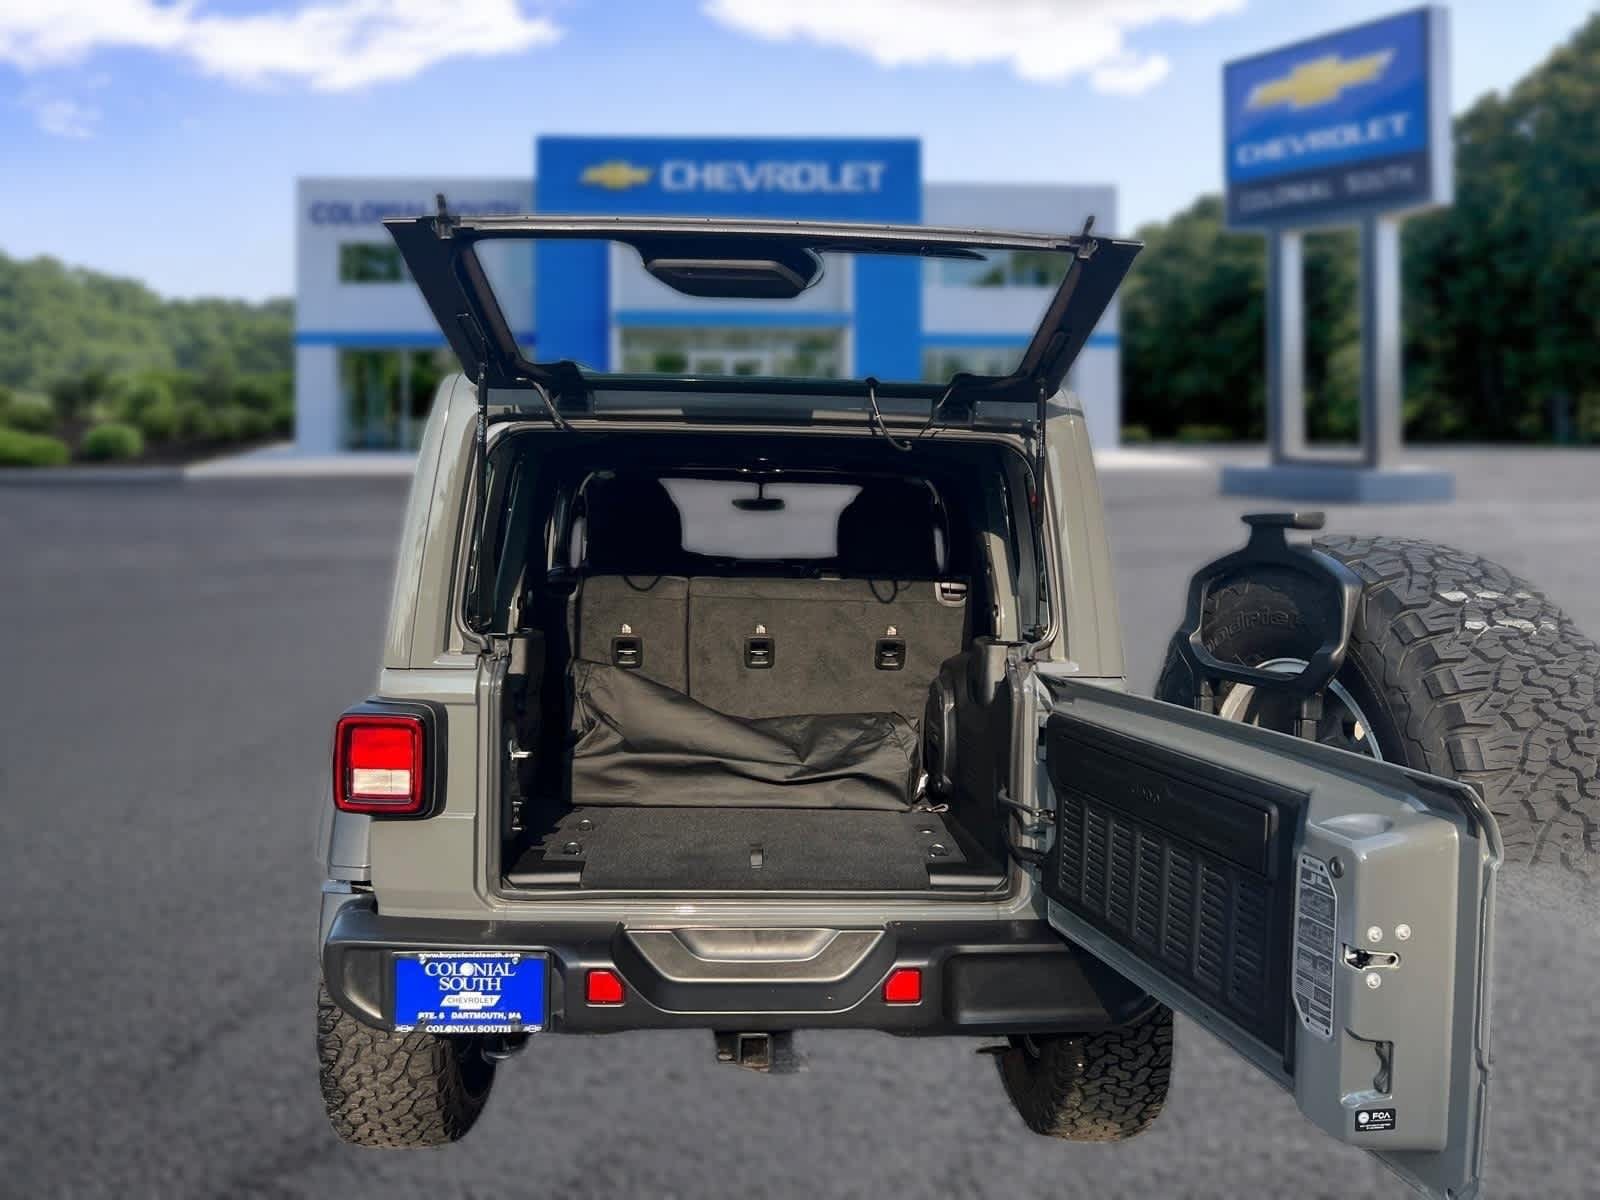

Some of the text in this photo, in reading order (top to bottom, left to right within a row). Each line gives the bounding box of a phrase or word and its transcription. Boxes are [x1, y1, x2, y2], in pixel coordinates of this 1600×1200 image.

[1236, 112, 1410, 167] CHEVROLET
[660, 160, 885, 193] CHEVROLET
[425, 962, 516, 976] COLONIAL
[439, 977, 502, 991] SOUTH
[446, 996, 494, 1004] CHEVROLET
[425, 1024, 512, 1033] COLONIAL SOUTH
[1372, 1111, 1391, 1119] FCA
